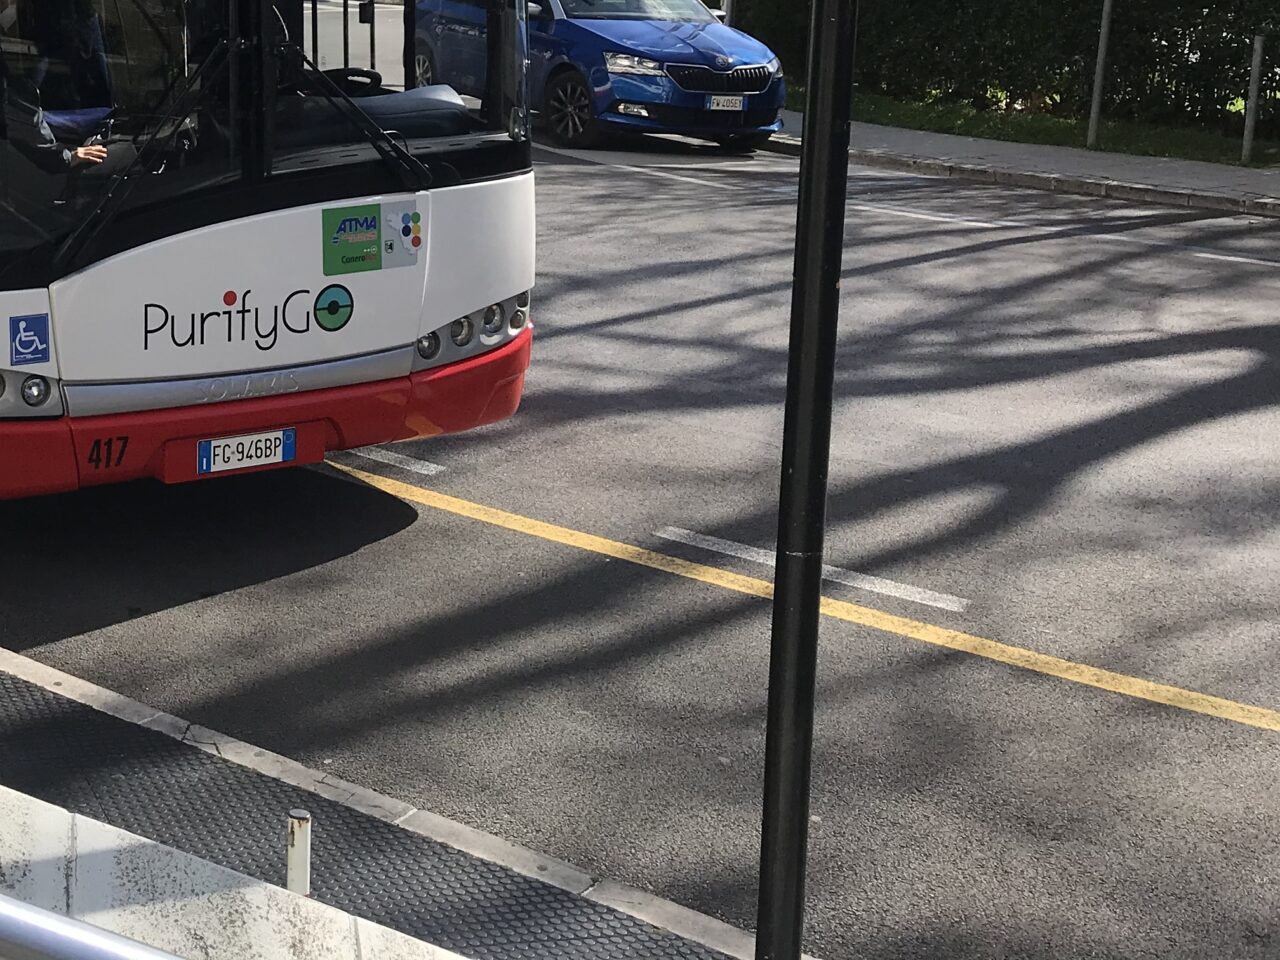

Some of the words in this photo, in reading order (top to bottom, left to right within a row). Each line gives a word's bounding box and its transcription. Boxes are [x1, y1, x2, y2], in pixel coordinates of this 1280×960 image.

[335, 215, 377, 234] ATMA
[144, 283, 354, 351] PurifyGO
[87, 435, 129, 470] 417
